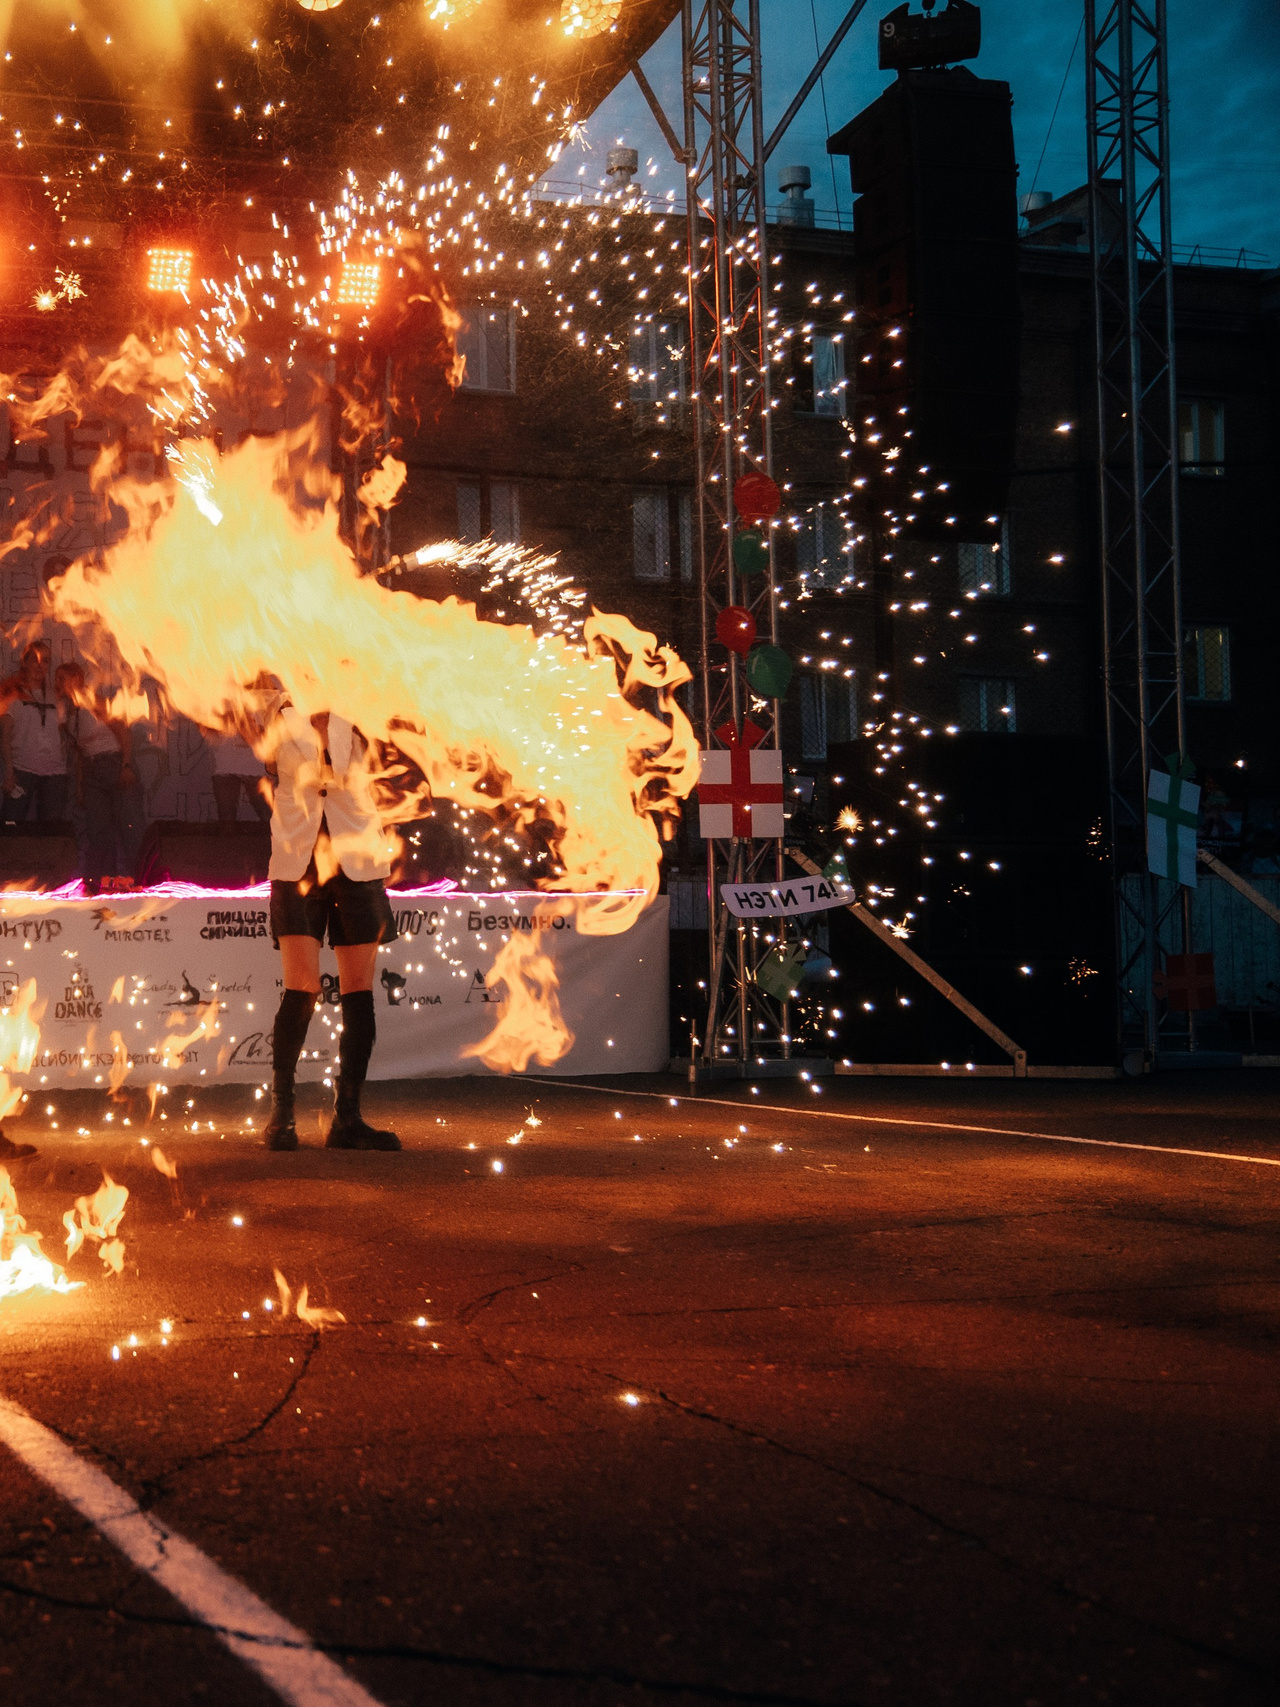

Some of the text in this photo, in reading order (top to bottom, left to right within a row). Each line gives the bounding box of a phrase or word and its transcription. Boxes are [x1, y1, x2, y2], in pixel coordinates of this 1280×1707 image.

[883, 22, 896, 38] 9
[734, 880, 839, 910] НЭТИ 74!
[468, 911, 571, 933] Безумно.
[104, 929, 174, 943] MIROTEL
[409, 996, 443, 1006] MONA
